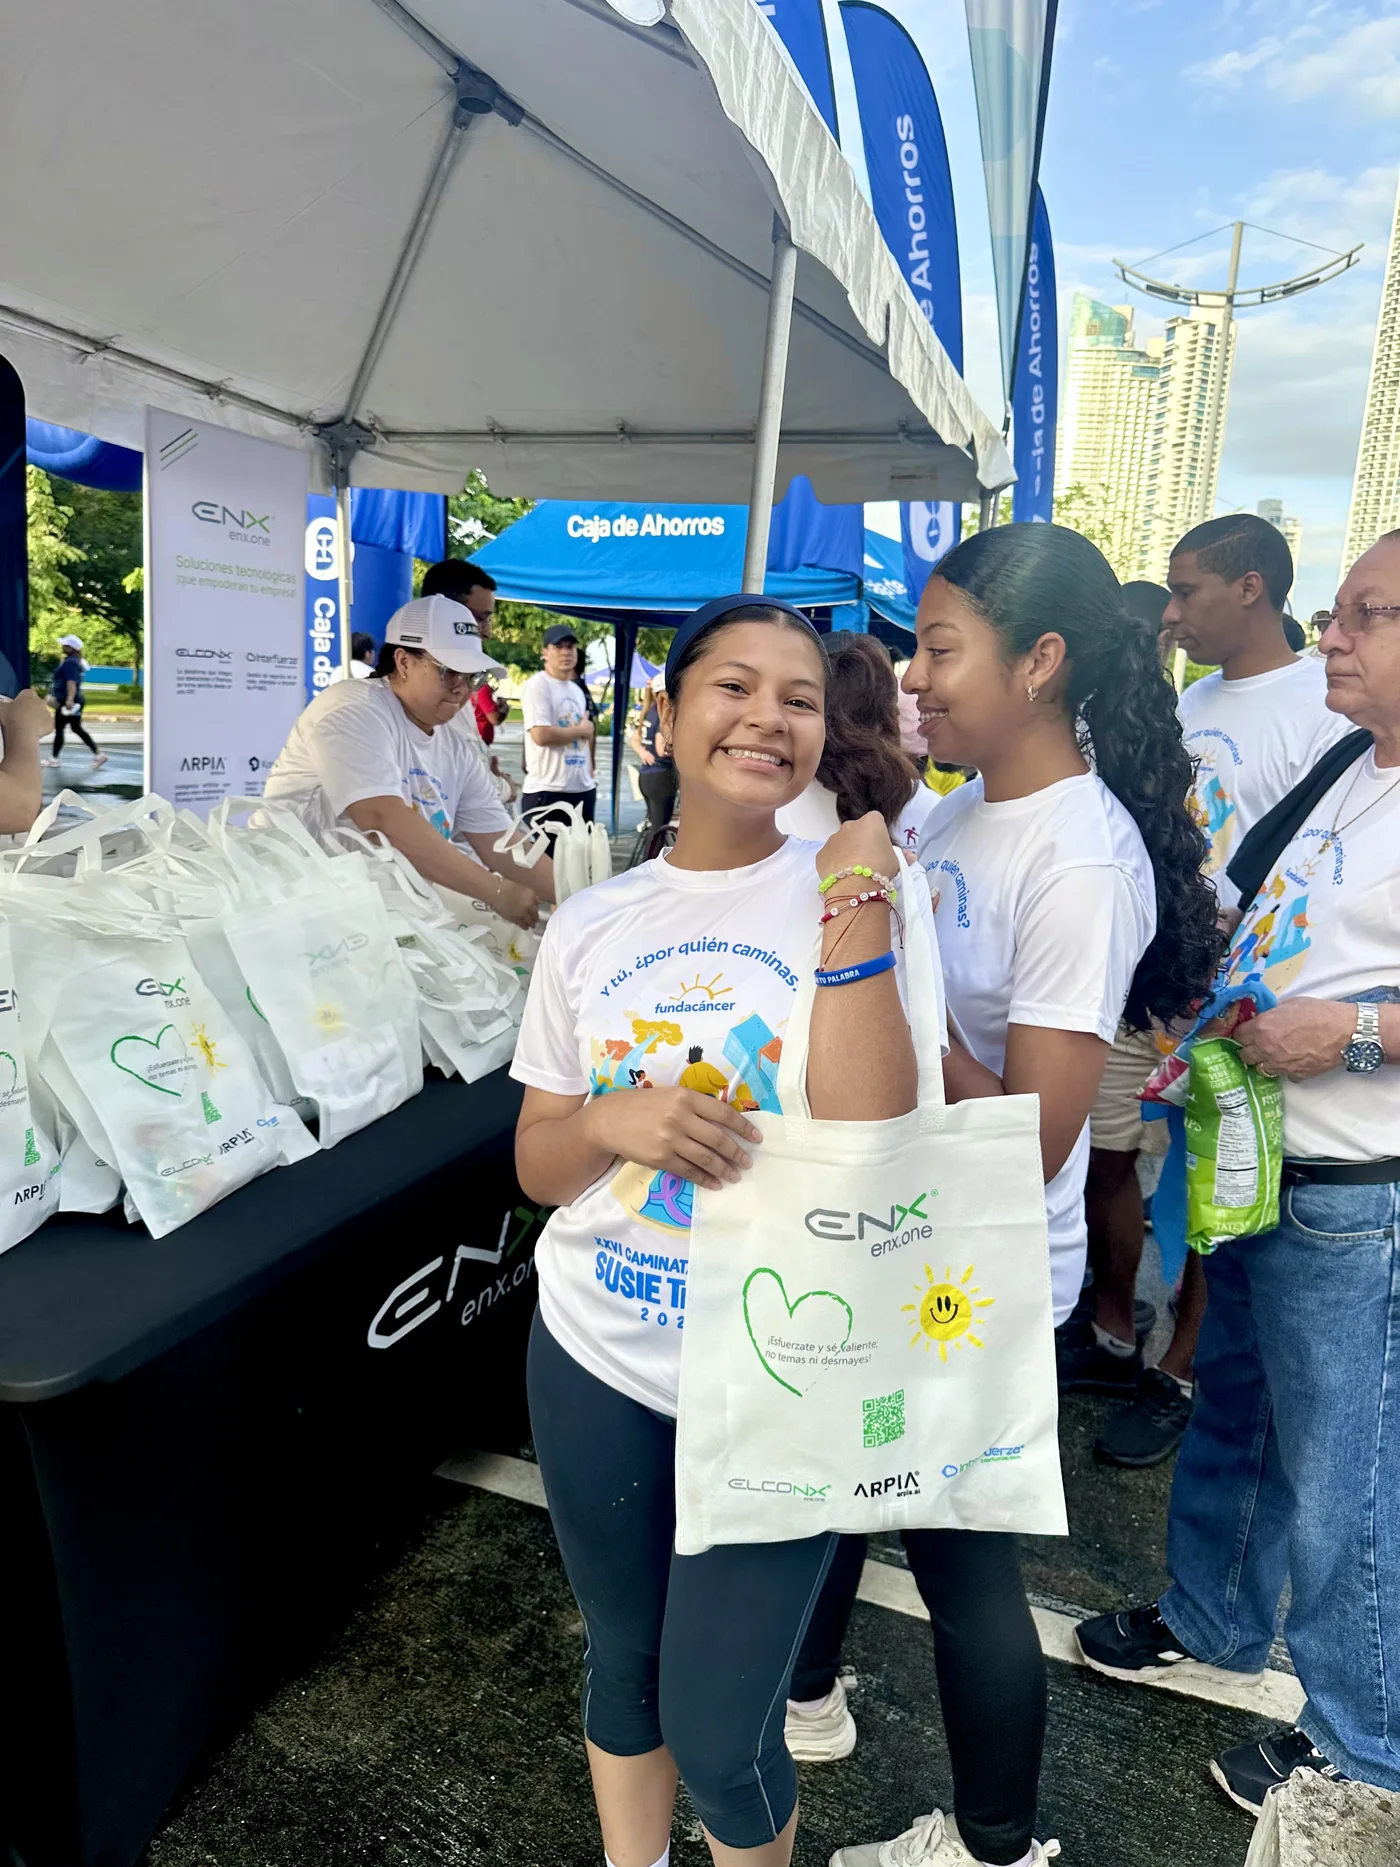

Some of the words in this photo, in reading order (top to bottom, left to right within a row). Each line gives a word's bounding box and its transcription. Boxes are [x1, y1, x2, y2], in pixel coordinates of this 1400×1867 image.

[897, 114, 933, 291] Ahorros
[1028, 242, 1043, 378] Ahorros
[1031, 384, 1045, 424] de
[191, 500, 271, 534] ENX
[567, 514, 611, 544] Caja
[612, 514, 639, 537] de
[639, 513, 725, 537] Ahorros
[229, 530, 272, 547] enx.one
[176, 555, 234, 575] Soluciones
[235, 564, 297, 585] tecnológicas
[309, 596, 337, 653] Caja
[312, 659, 332, 687] de
[180, 756, 226, 772] ARPIA
[955, 872, 971, 928] caminas?
[611, 967, 633, 988] tú,
[635, 943, 675, 971] ¿por
[677, 936, 729, 955] quién
[732, 943, 801, 992] caminas
[819, 976, 827, 985] TU
[826, 968, 861, 984] PALABRA
[654, 1000, 736, 1014] fundacáncer
[14, 1184, 46, 1205] ARPI
[804, 1193, 928, 1241] ENX
[870, 1224, 933, 1258] enx.one
[625, 1246, 689, 1275] CAMINAT
[595, 1251, 662, 1305] SUSIE
[765, 1350, 777, 1359] no
[778, 1353, 806, 1364] temas
[808, 1356, 818, 1364] ni
[821, 1354, 872, 1367] desmayes!
[767, 1335, 816, 1352] ¡Esfuerzate
[818, 1344, 825, 1354] y
[827, 1343, 838, 1353] sé
[854, 1471, 919, 1498] ARPIA
